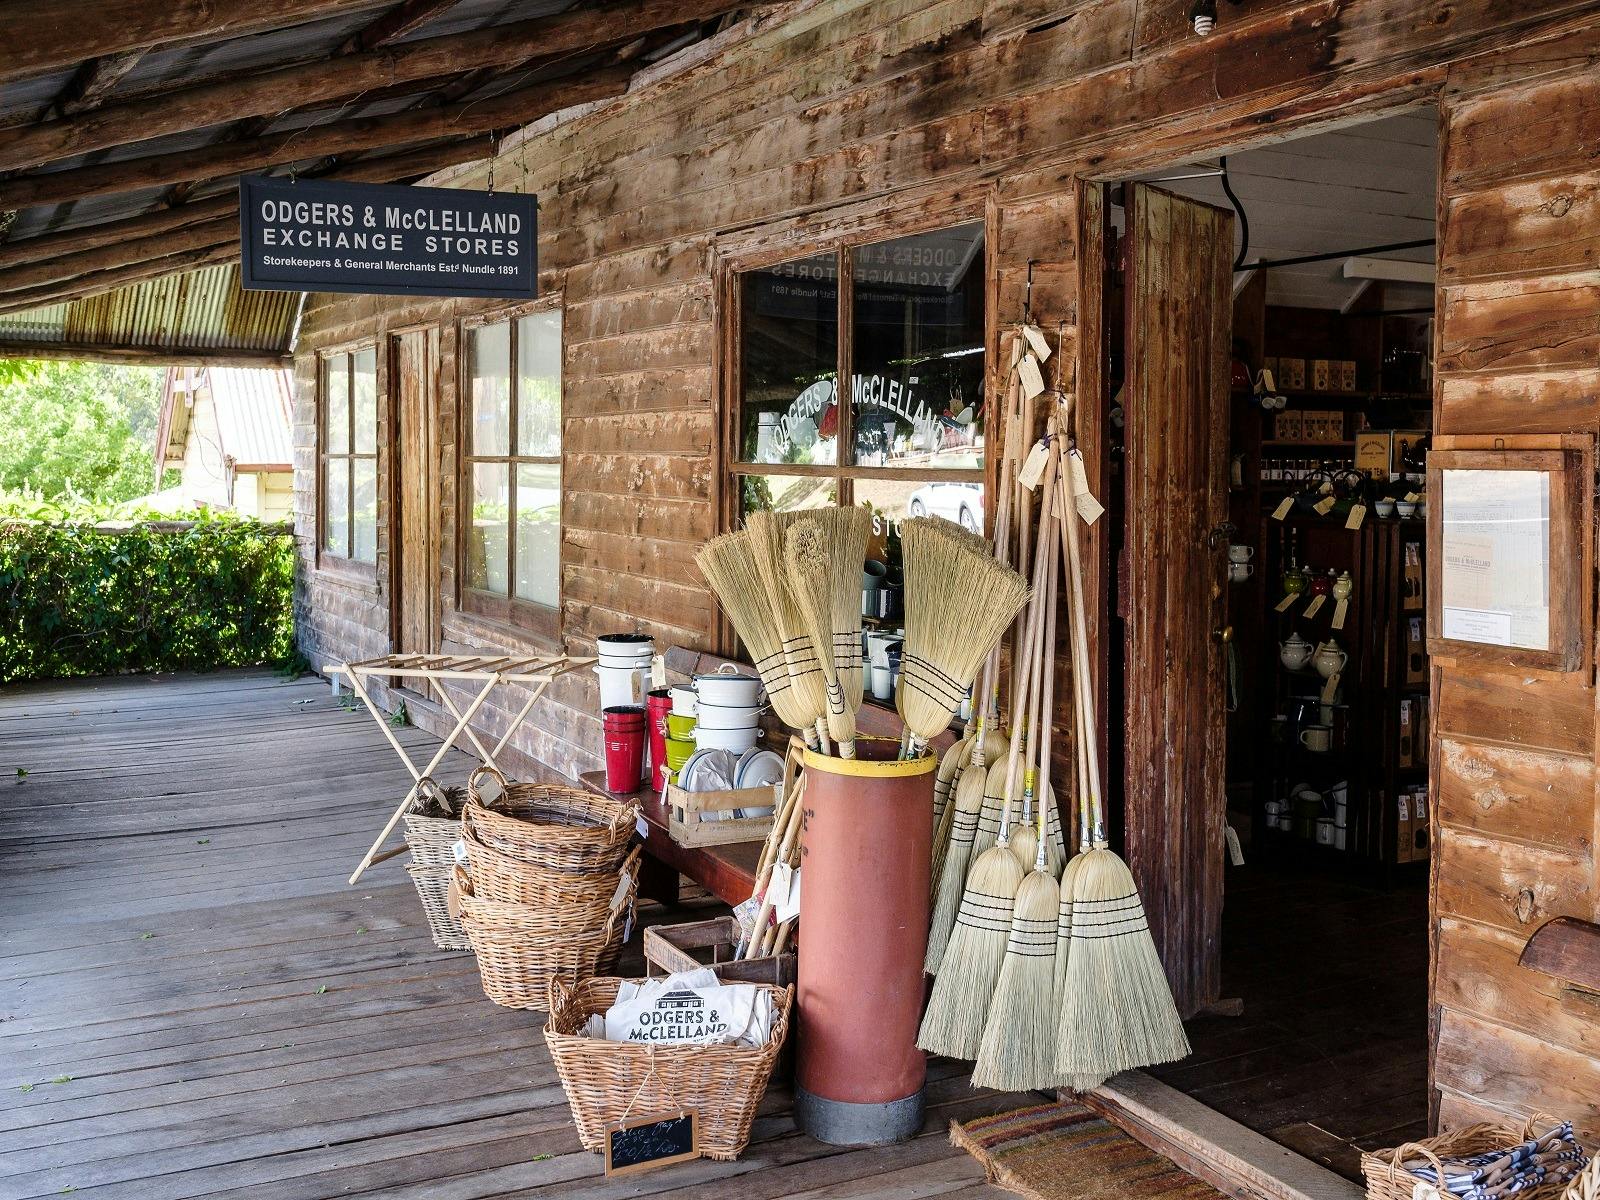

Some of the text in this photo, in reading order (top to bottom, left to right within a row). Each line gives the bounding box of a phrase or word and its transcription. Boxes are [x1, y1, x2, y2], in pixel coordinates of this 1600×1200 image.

[261, 200, 521, 235] ODGERS & McCLELLAND
[263, 228, 519, 256] EXCHANGE STORES
[263, 255, 331, 269] Storekeepers
[334, 258, 342, 268] &
[344, 258, 383, 270] General
[385, 260, 436, 272] Merchants
[462, 263, 495, 274] Nundle
[497, 265, 519, 275] 1891
[772, 384, 821, 452] ODGERS
[639, 1010, 720, 1026] ODGERS &
[629, 1023, 728, 1041] McCLELLAND
